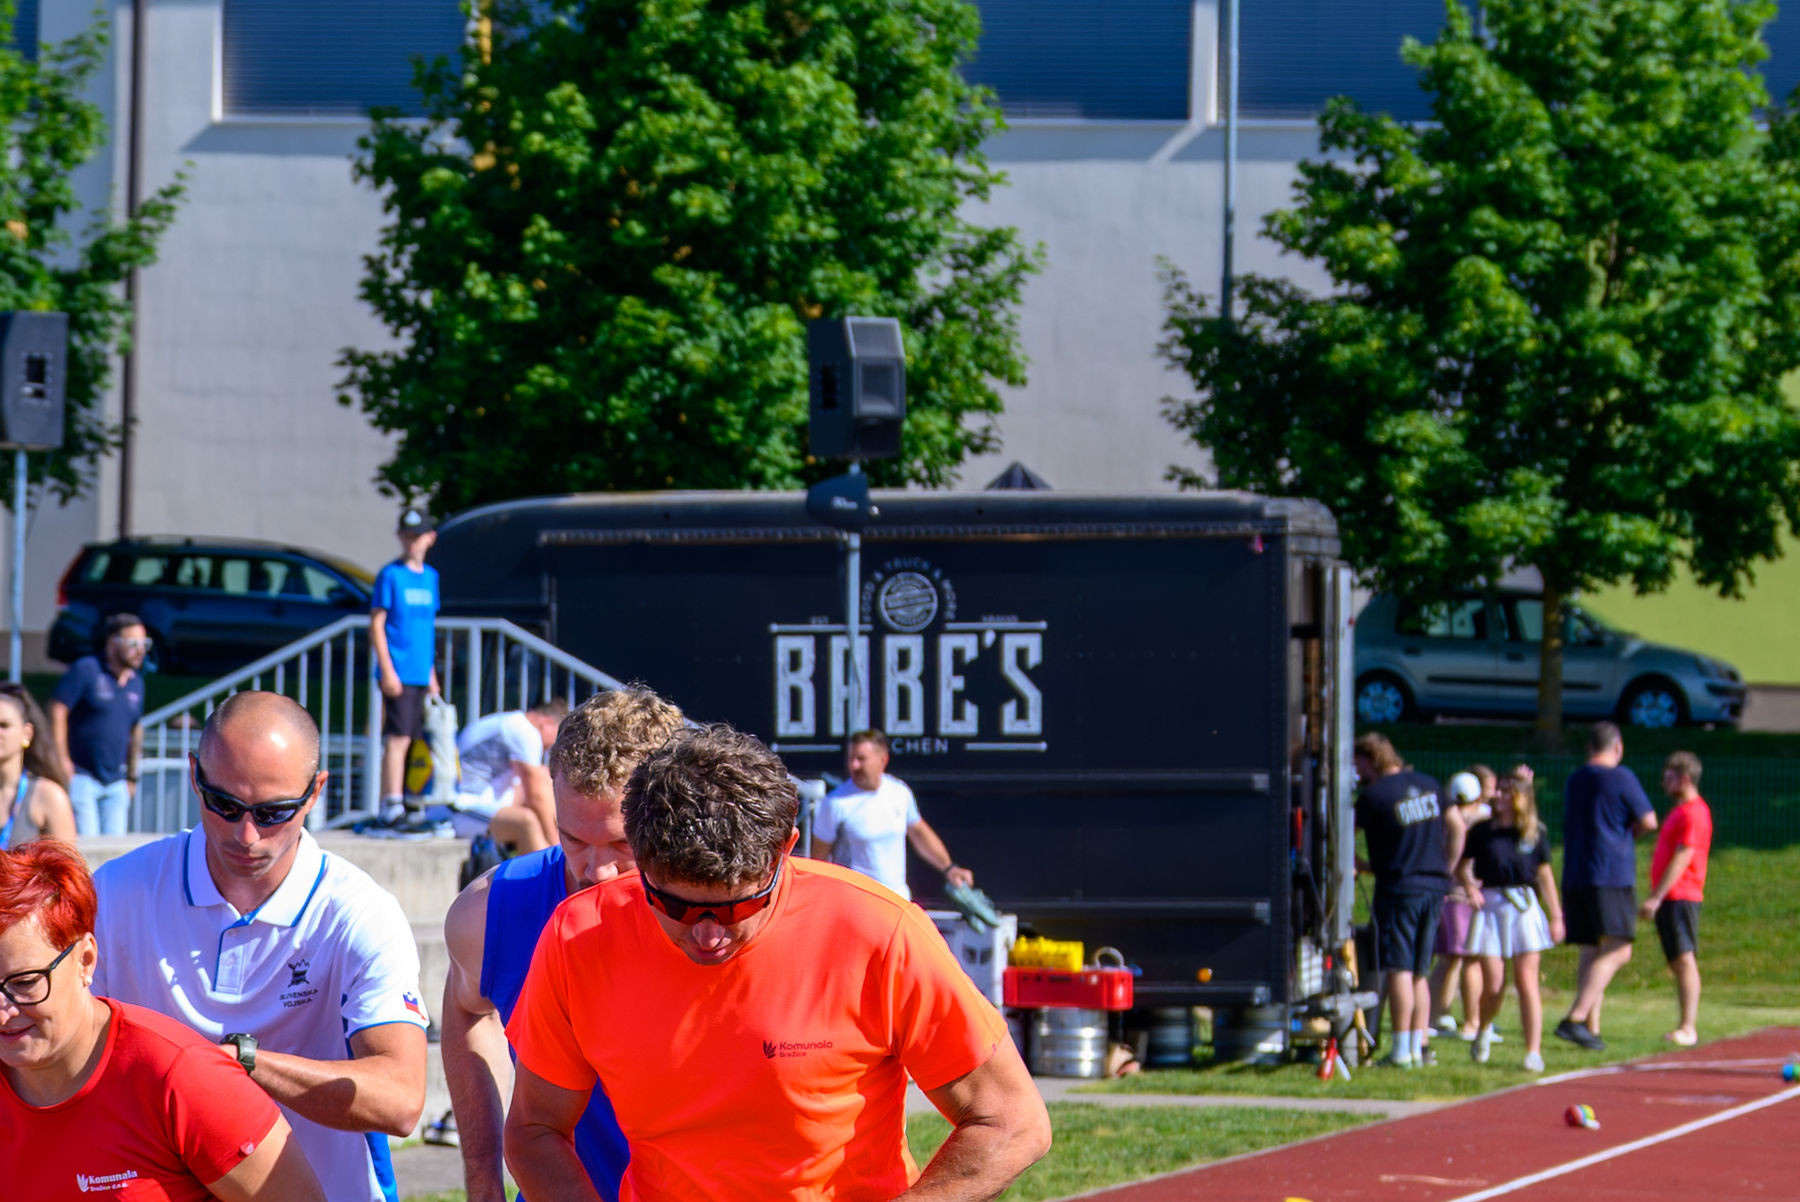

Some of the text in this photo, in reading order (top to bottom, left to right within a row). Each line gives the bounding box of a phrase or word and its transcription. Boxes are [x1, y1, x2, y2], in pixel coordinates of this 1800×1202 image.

[776, 629, 1042, 737] BABE'S
[890, 738, 949, 754] CHEN
[779, 1040, 833, 1050] Komunala
[88, 1169, 138, 1184] Komunala
